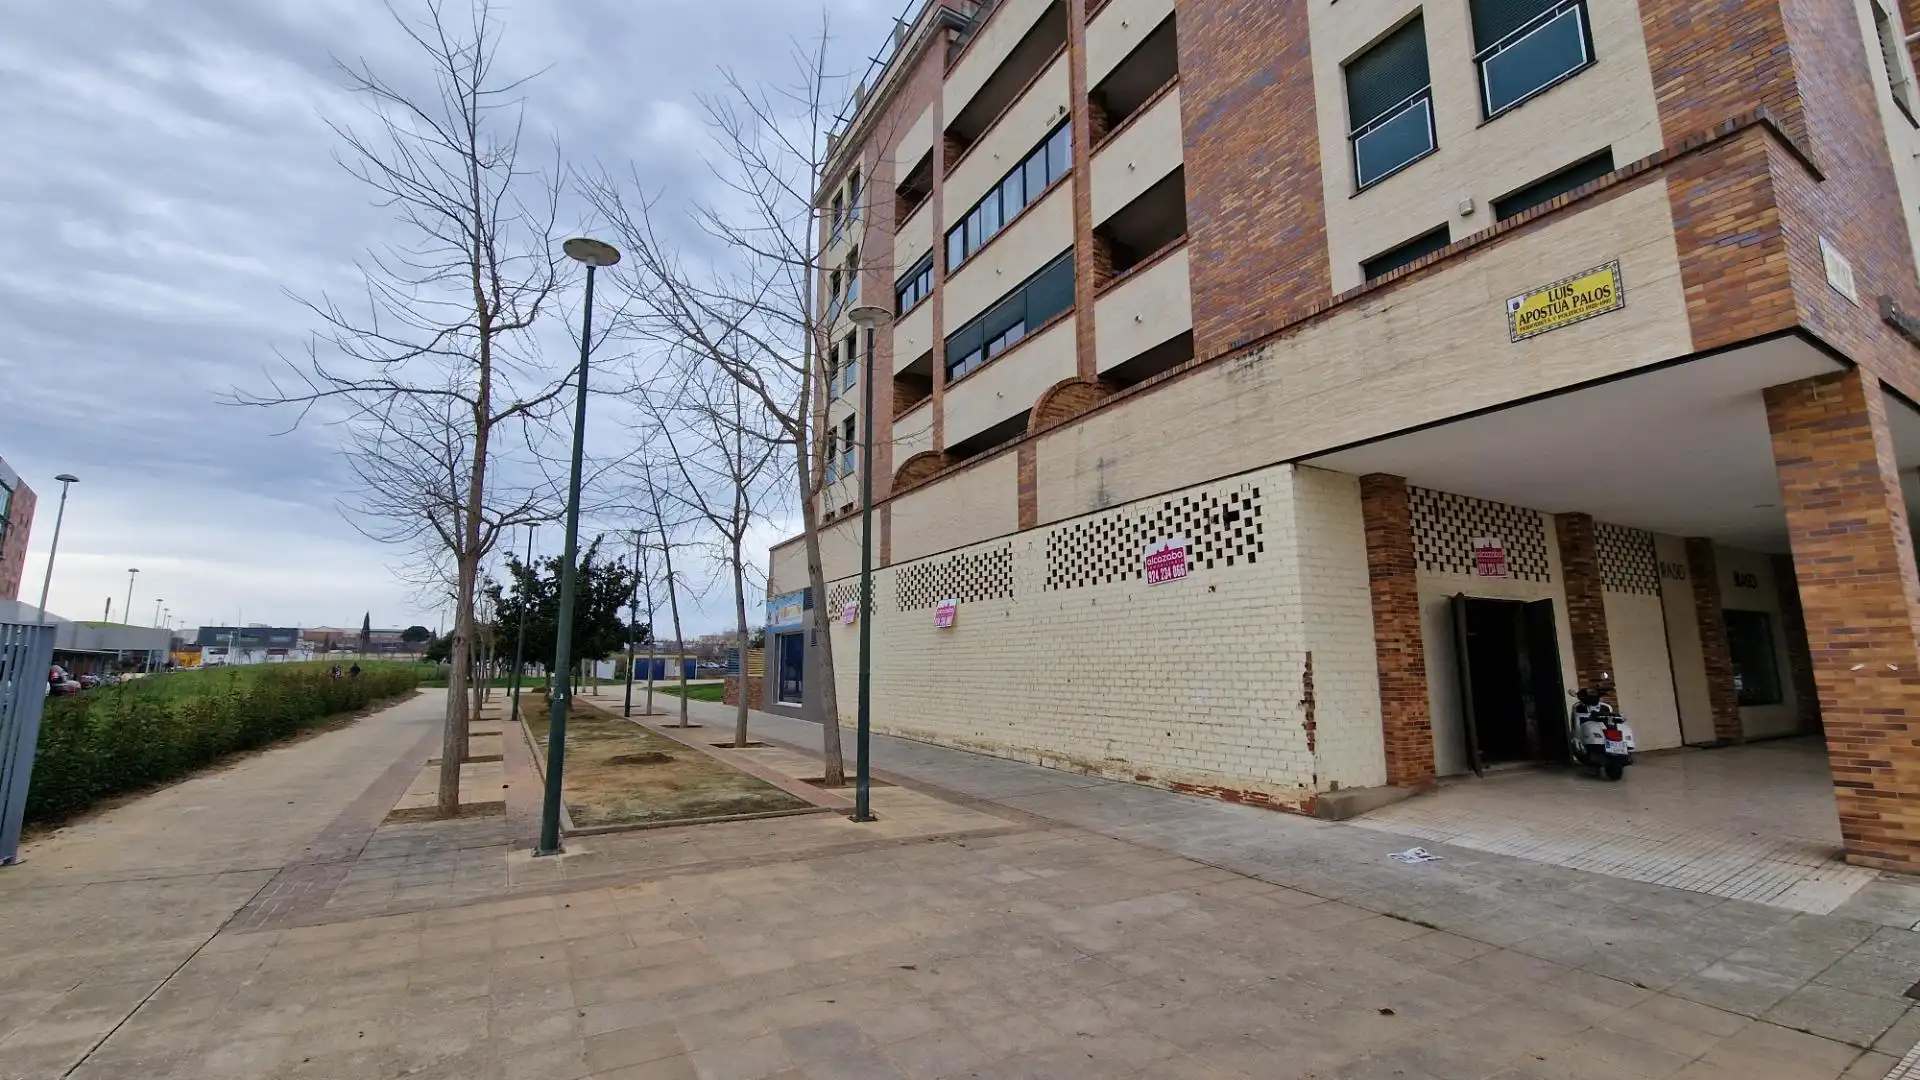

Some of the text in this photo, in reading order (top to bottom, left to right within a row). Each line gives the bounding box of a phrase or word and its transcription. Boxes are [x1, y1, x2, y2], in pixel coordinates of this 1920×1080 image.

[1548, 284, 1574, 302] LUIS
[1519, 285, 1611, 326] APOSTUA PALOS
[1148, 569, 1160, 583] 924
